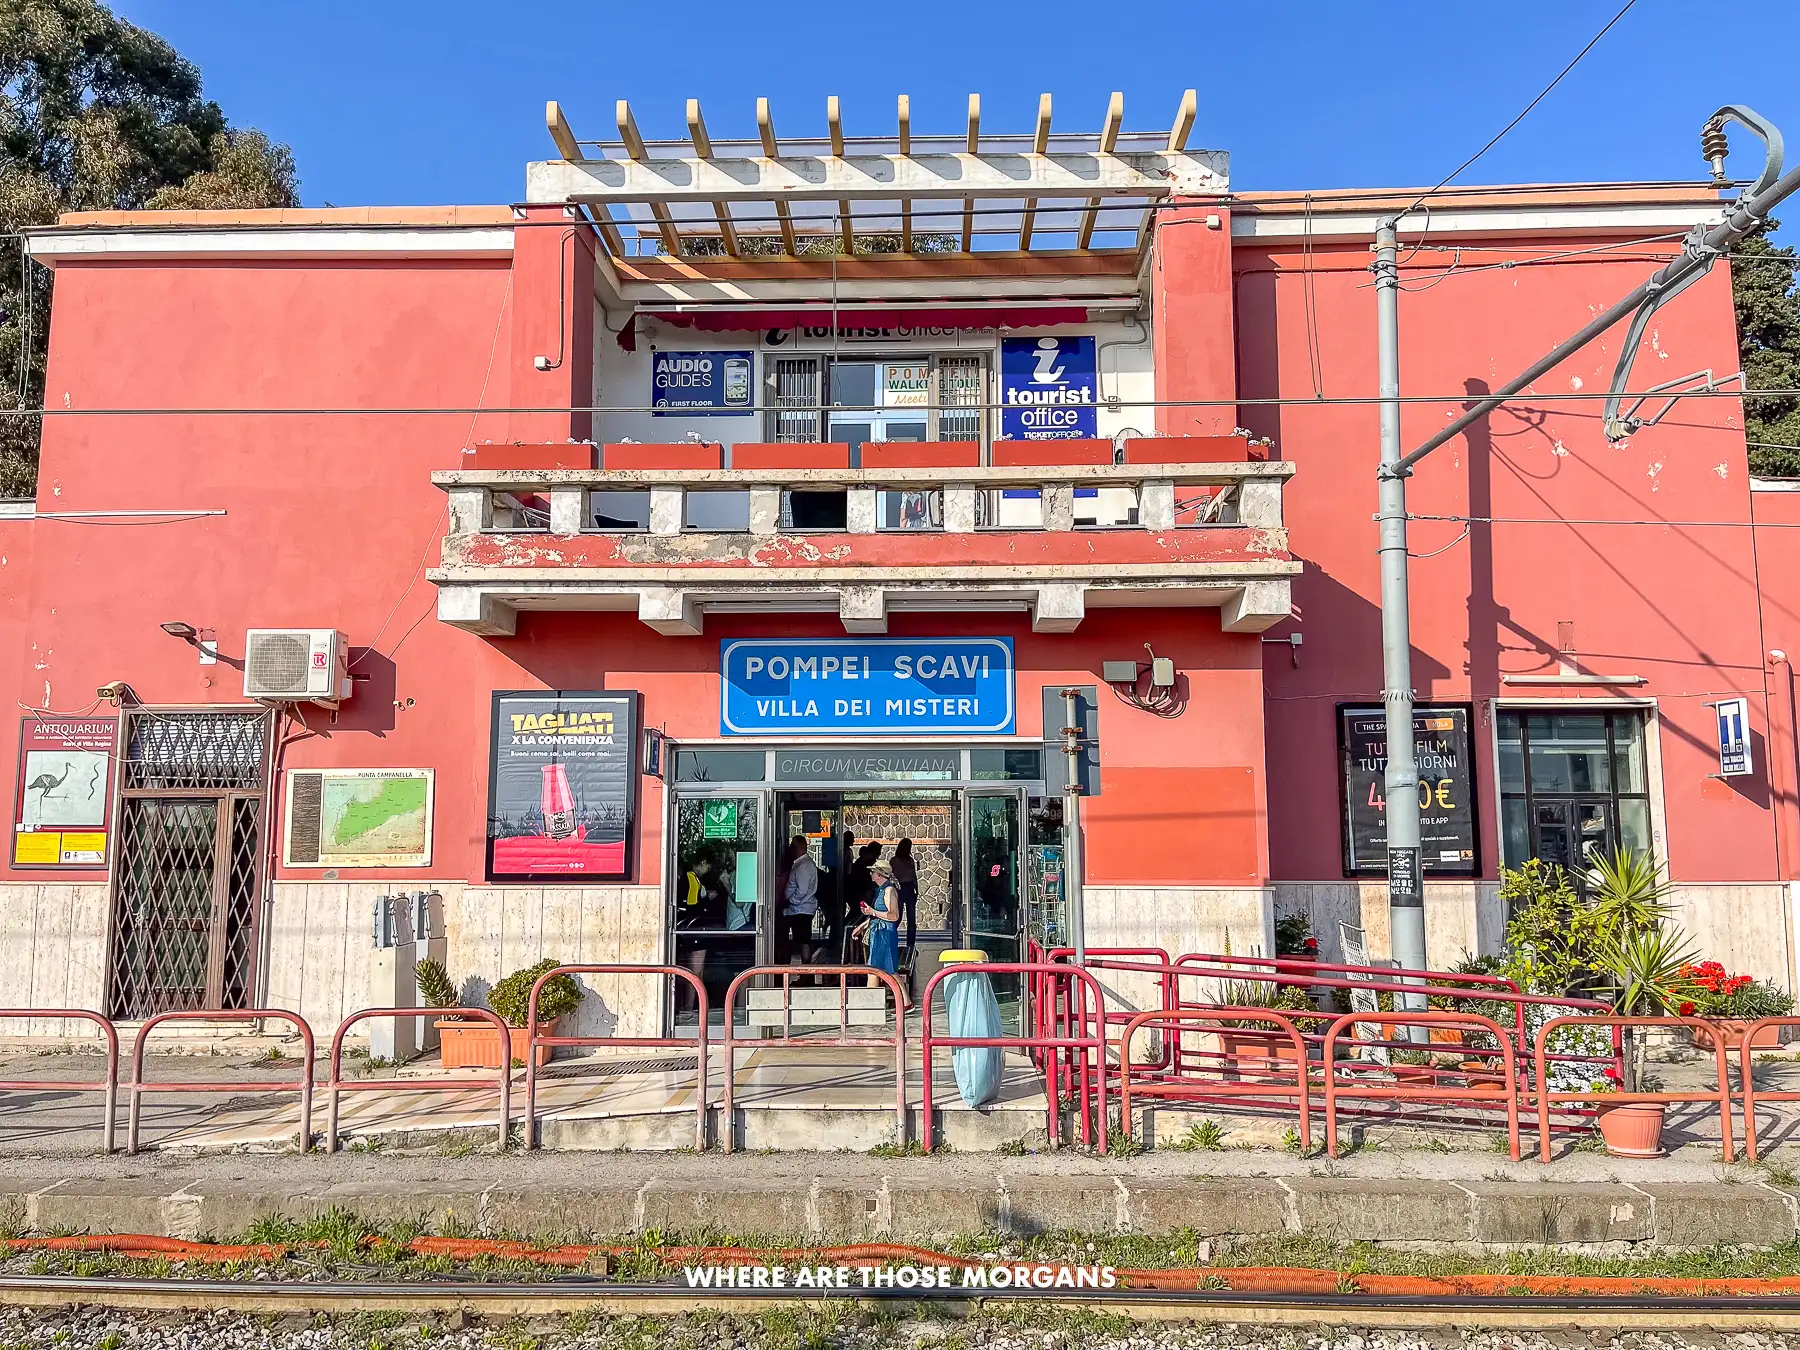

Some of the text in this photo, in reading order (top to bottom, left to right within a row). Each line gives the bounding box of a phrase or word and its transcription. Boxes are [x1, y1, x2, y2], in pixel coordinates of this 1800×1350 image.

[656, 359, 713, 373] AUDIO
[656, 373, 712, 388] GUIDES
[888, 380, 945, 390] WALKIG
[894, 393, 928, 405] Meeti
[1007, 385, 1091, 405] tourist
[1020, 407, 1078, 426] office
[746, 655, 989, 680] POMPEI SCAVI
[756, 698, 979, 717] VILLA DEI MISTERI
[34, 724, 113, 736] ANTIQUARIUM
[510, 712, 614, 735] TAGLIATI
[1376, 723, 1387, 731] SPA
[511, 735, 614, 745] X LA CONVENIENZA
[1416, 740, 1447, 754] FILM
[781, 757, 957, 774] CIRCUMVESUVIANA
